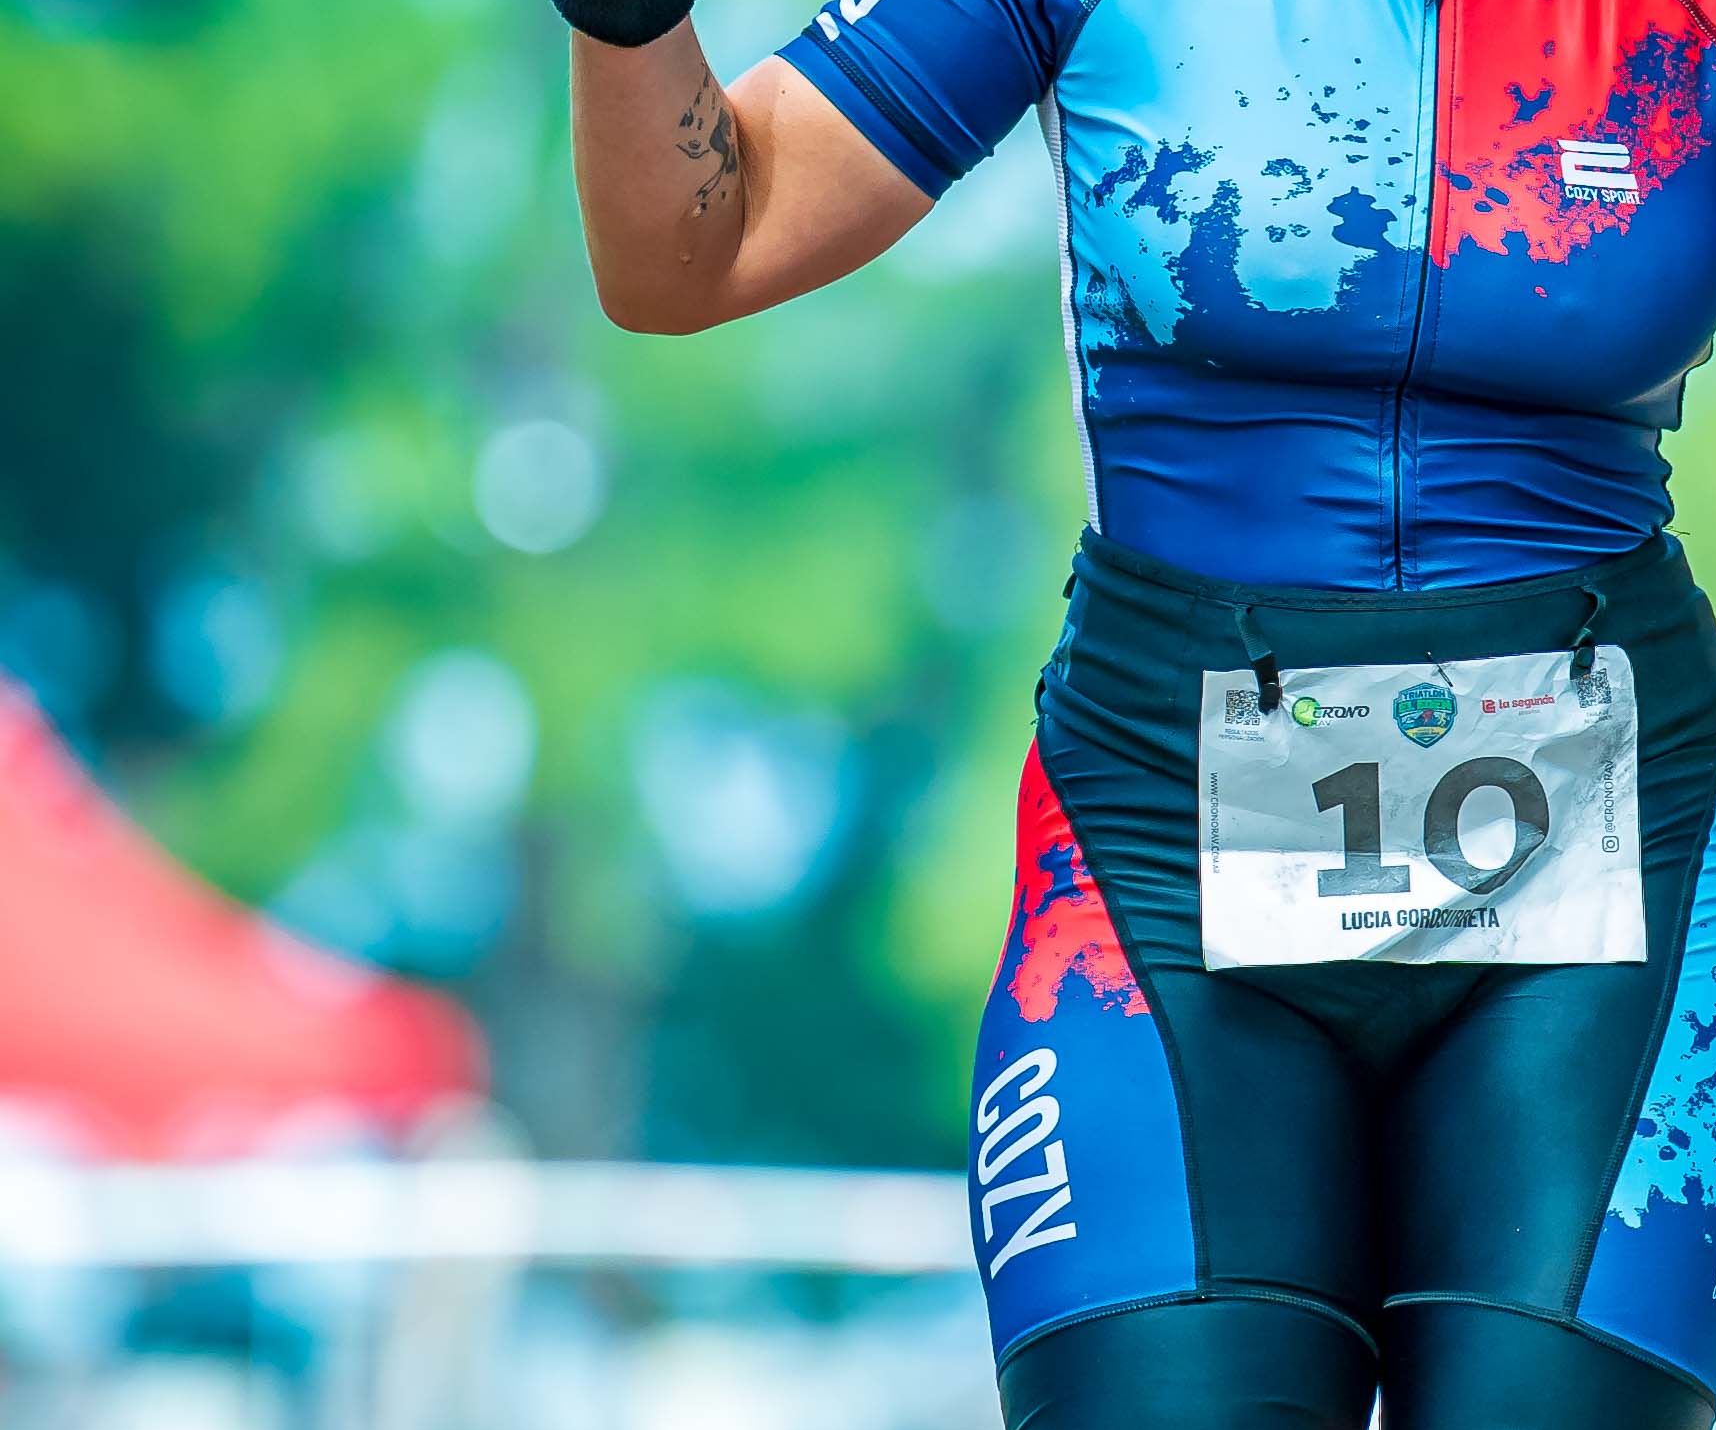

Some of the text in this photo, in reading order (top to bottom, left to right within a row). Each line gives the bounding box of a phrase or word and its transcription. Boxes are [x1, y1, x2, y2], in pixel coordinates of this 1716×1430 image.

[1564, 185, 1641, 205] COZY SPORT
[1511, 693, 1555, 709] segunda
[1312, 705, 1370, 719] CRONO
[1603, 759, 1616, 833] @CRONORAV
[1311, 756, 1550, 898] 10
[1341, 910, 1392, 930] LUCIA
[977, 1047, 1078, 1280] COZY
